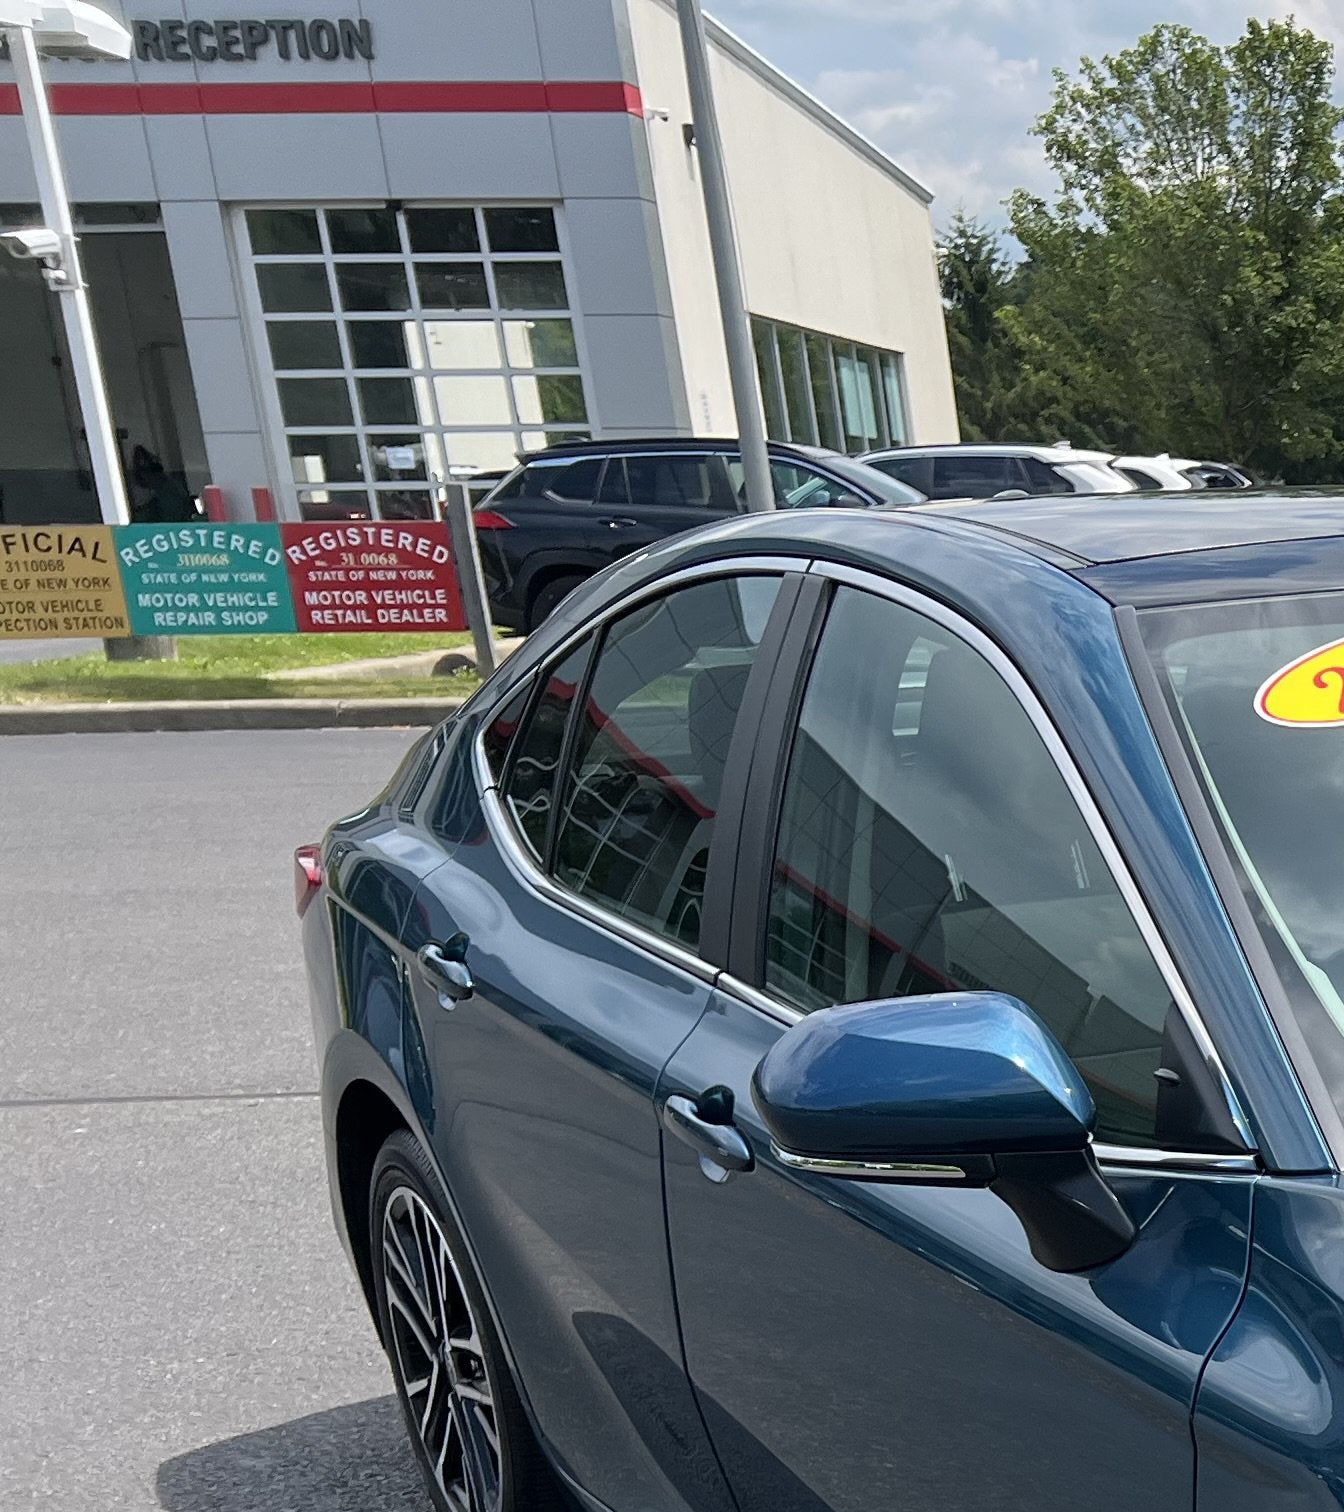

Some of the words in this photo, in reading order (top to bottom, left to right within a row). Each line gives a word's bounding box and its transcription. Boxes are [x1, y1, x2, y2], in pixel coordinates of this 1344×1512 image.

[130, 19, 375, 62] RECEPTION
[119, 528, 282, 567] REGISTERED
[286, 527, 449, 565] REGISTERED
[13, 578, 31, 590] OF
[37, 577, 68, 590] NEW
[71, 576, 112, 589] YORK
[141, 572, 178, 584] STATE
[181, 572, 198, 584] OF
[201, 572, 229, 584] NEW
[231, 572, 267, 583] YORK
[308, 570, 346, 582] STATE
[349, 570, 365, 581] OF
[369, 570, 397, 581] NEW
[400, 569, 435, 580] YORK
[138, 592, 200, 607] MOTOR
[203, 591, 279, 607] VEHICLE
[304, 590, 369, 606] MOTOR
[371, 589, 448, 605] VEHICLE
[40, 599, 104, 614] VEHICLE
[64, 616, 125, 631] STATION
[153, 611, 216, 627] REPAIR
[221, 611, 269, 626] SHOP
[310, 609, 373, 625] RETAIL
[377, 608, 449, 624] DEALER
